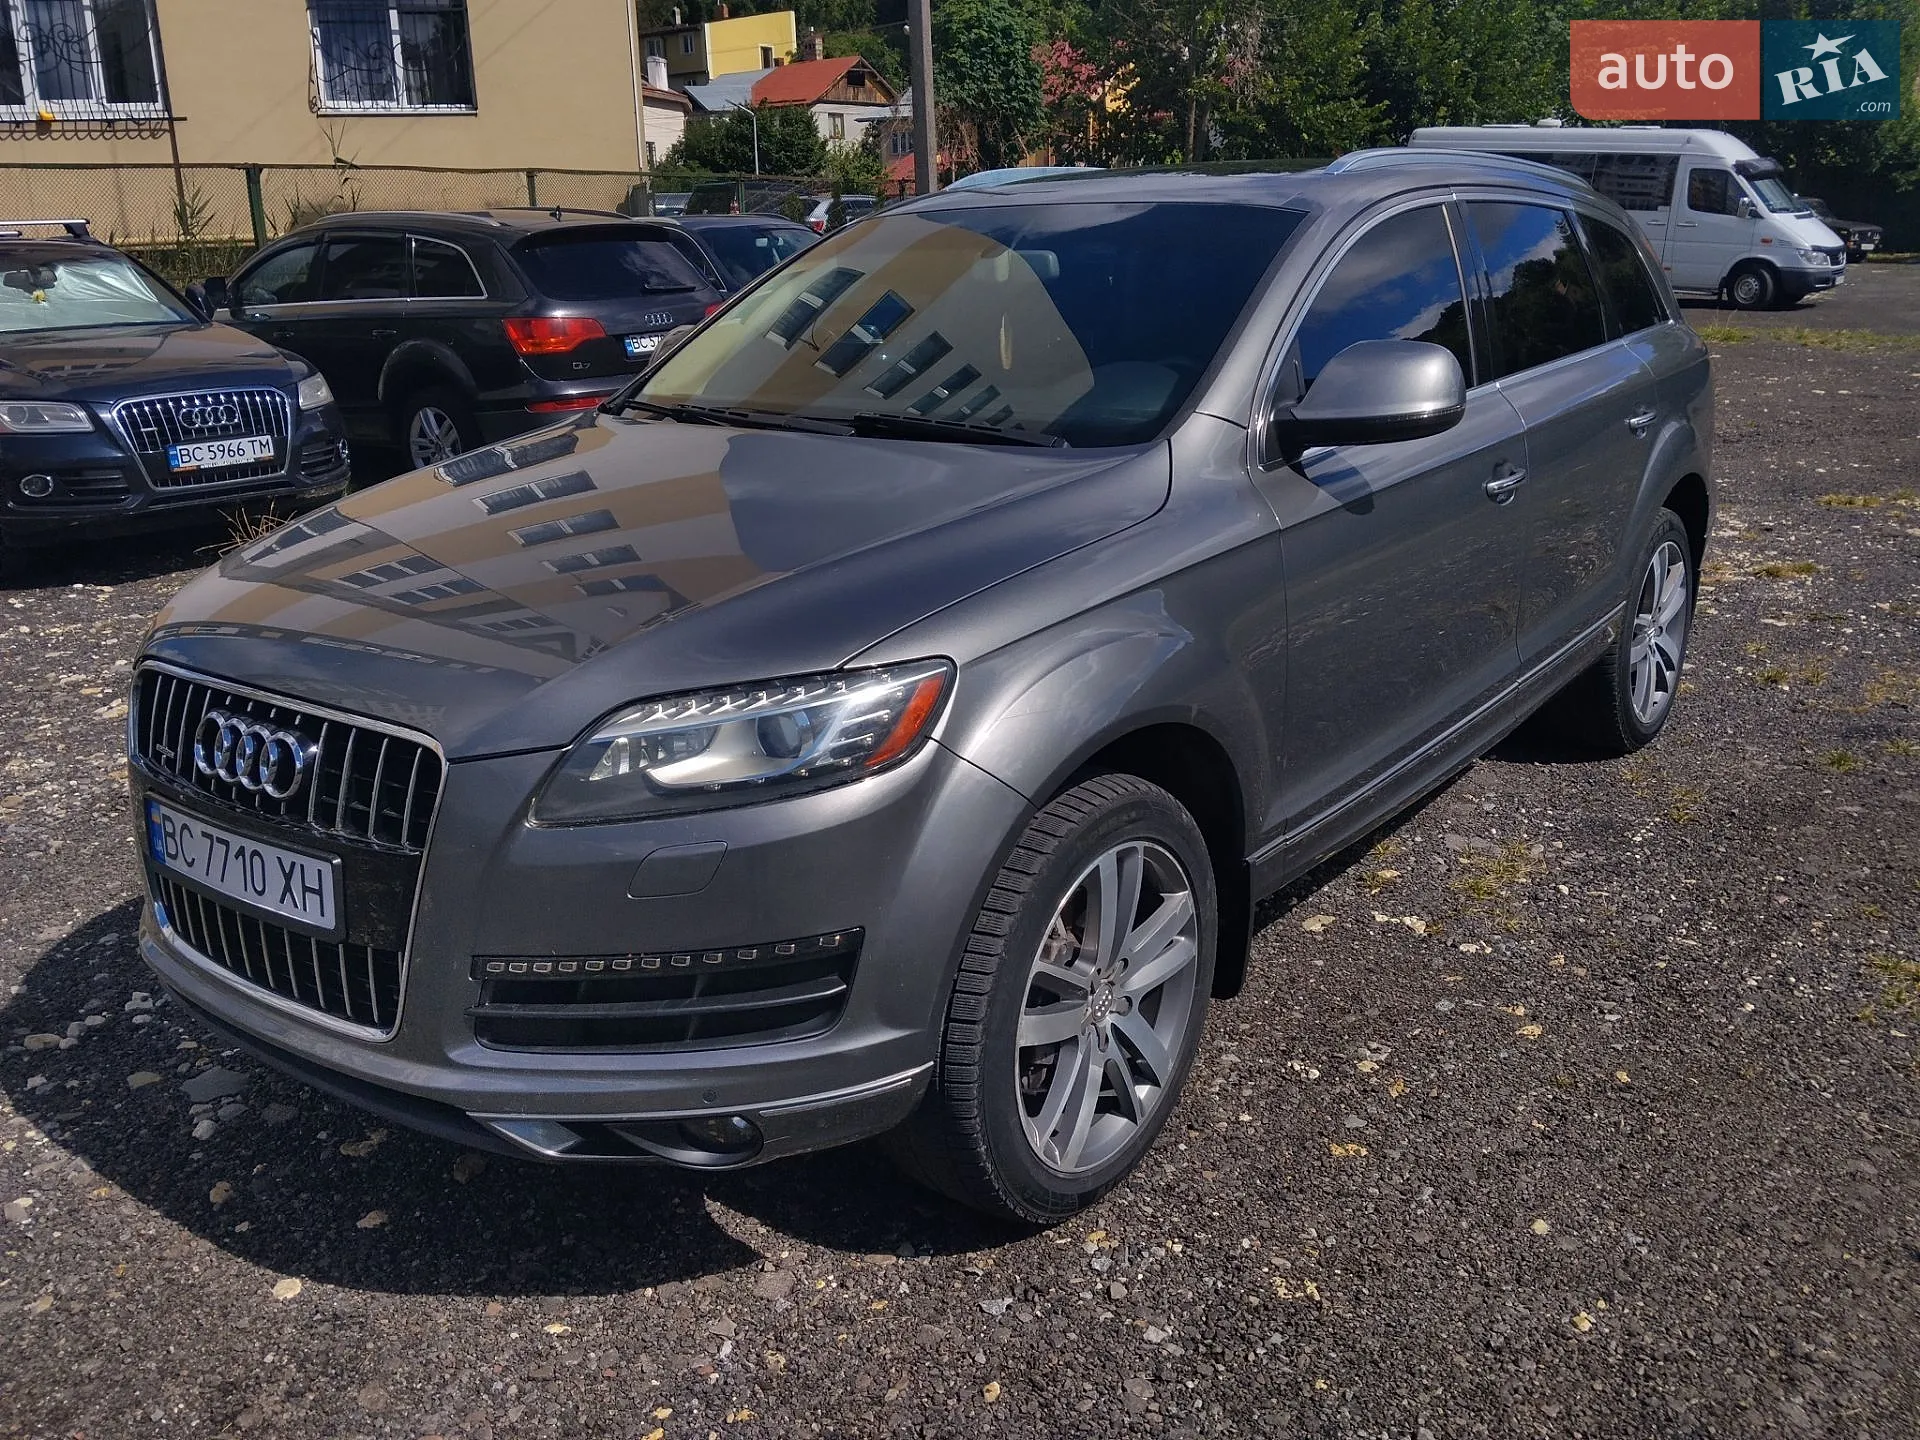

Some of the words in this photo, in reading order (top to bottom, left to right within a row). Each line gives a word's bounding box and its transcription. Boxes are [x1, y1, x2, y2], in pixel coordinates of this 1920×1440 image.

[631, 336, 648, 350] BC
[572, 362, 591, 370] Q7
[178, 447, 204, 463] BC
[207, 442, 246, 460] 5966
[248, 439, 271, 455] TM
[162, 813, 195, 867] BC
[201, 831, 266, 897] 7710
[276, 856, 325, 917] XH
